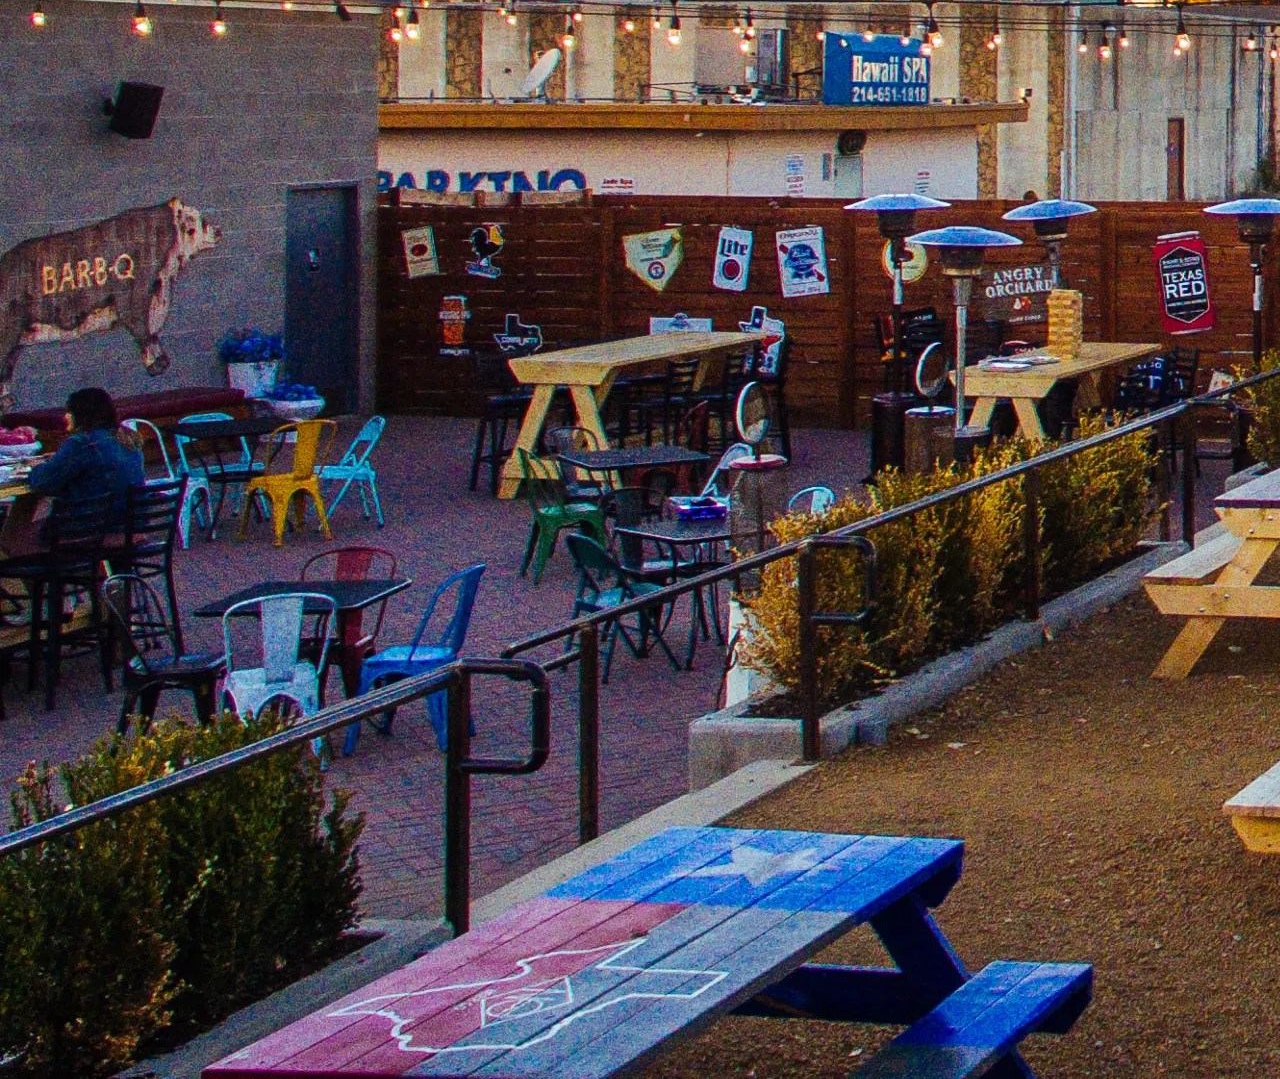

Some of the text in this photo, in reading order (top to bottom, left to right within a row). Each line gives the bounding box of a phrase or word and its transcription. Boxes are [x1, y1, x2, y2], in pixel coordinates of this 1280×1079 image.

[852, 54, 928, 83] Hawaii SPA
[720, 237, 749, 258] Lite
[993, 266, 1044, 285] ANGRY
[1163, 268, 1204, 284] TEXAS
[985, 279, 1053, 299] ORCHARD
[1165, 280, 1206, 300] RED
